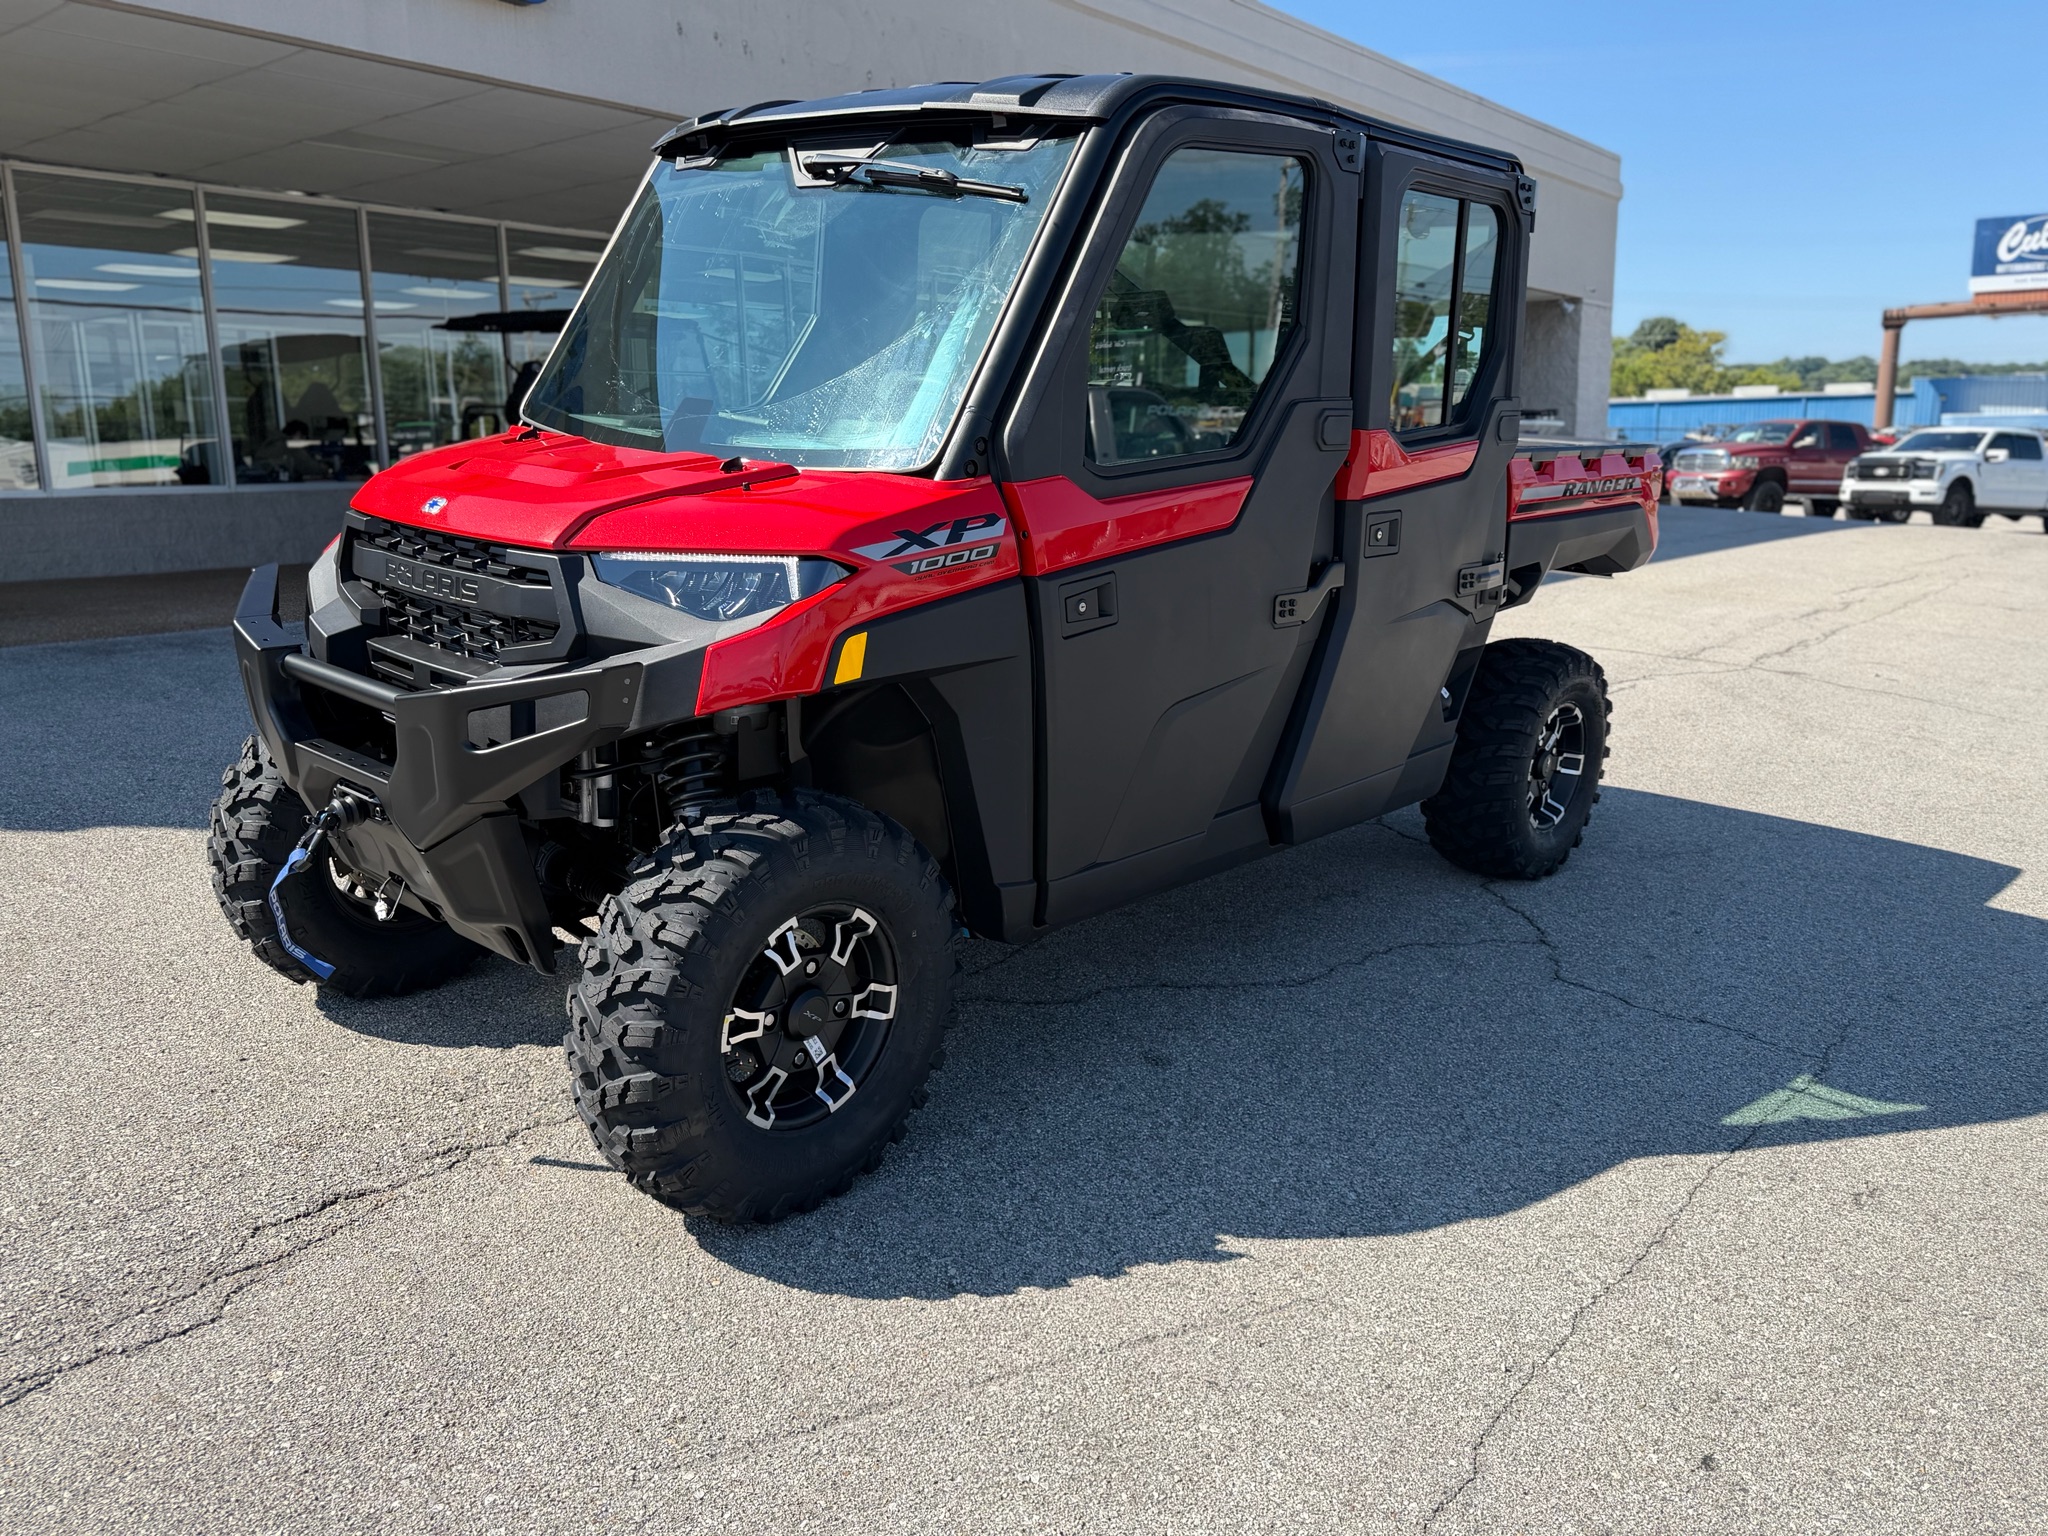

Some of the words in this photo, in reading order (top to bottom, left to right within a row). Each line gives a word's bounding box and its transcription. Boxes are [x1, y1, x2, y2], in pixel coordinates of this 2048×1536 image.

[1562, 477, 1636, 497] RANGER
[881, 513, 1002, 559] XP
[911, 545, 994, 574] 1000
[914, 573, 934, 582] DUAL
[937, 563, 978, 576] OVERHEAD
[385, 558, 480, 604] POLARIS
[270, 889, 307, 959] POLARIS
